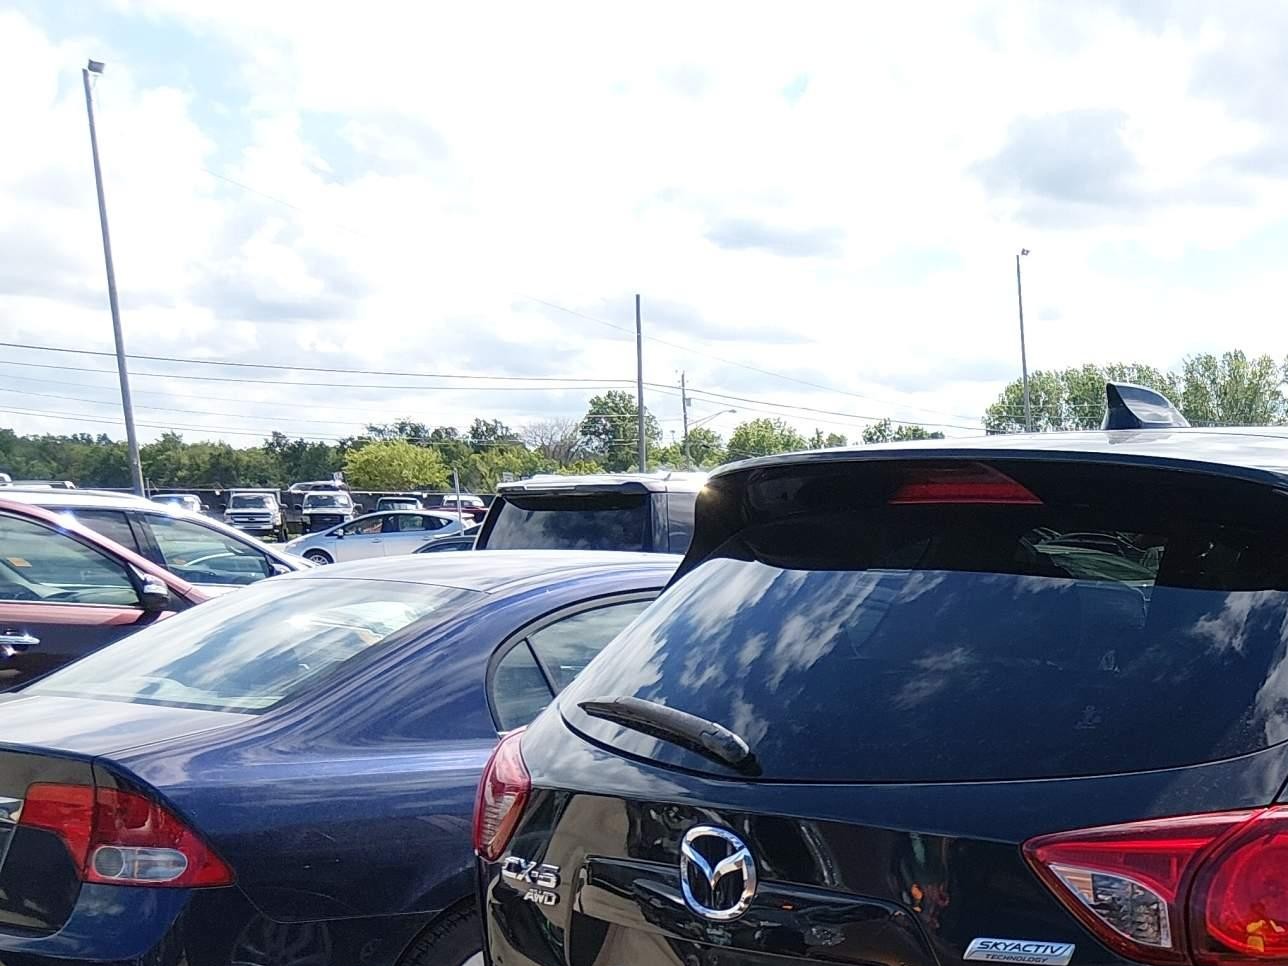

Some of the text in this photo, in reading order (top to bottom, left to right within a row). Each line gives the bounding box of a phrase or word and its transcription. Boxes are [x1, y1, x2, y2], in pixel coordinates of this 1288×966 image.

[501, 856, 560, 889] CX-5
[523, 888, 557, 906] AWD
[976, 940, 1064, 955] SKYACTIV
[984, 953, 1049, 963] TECHNOLOGY
